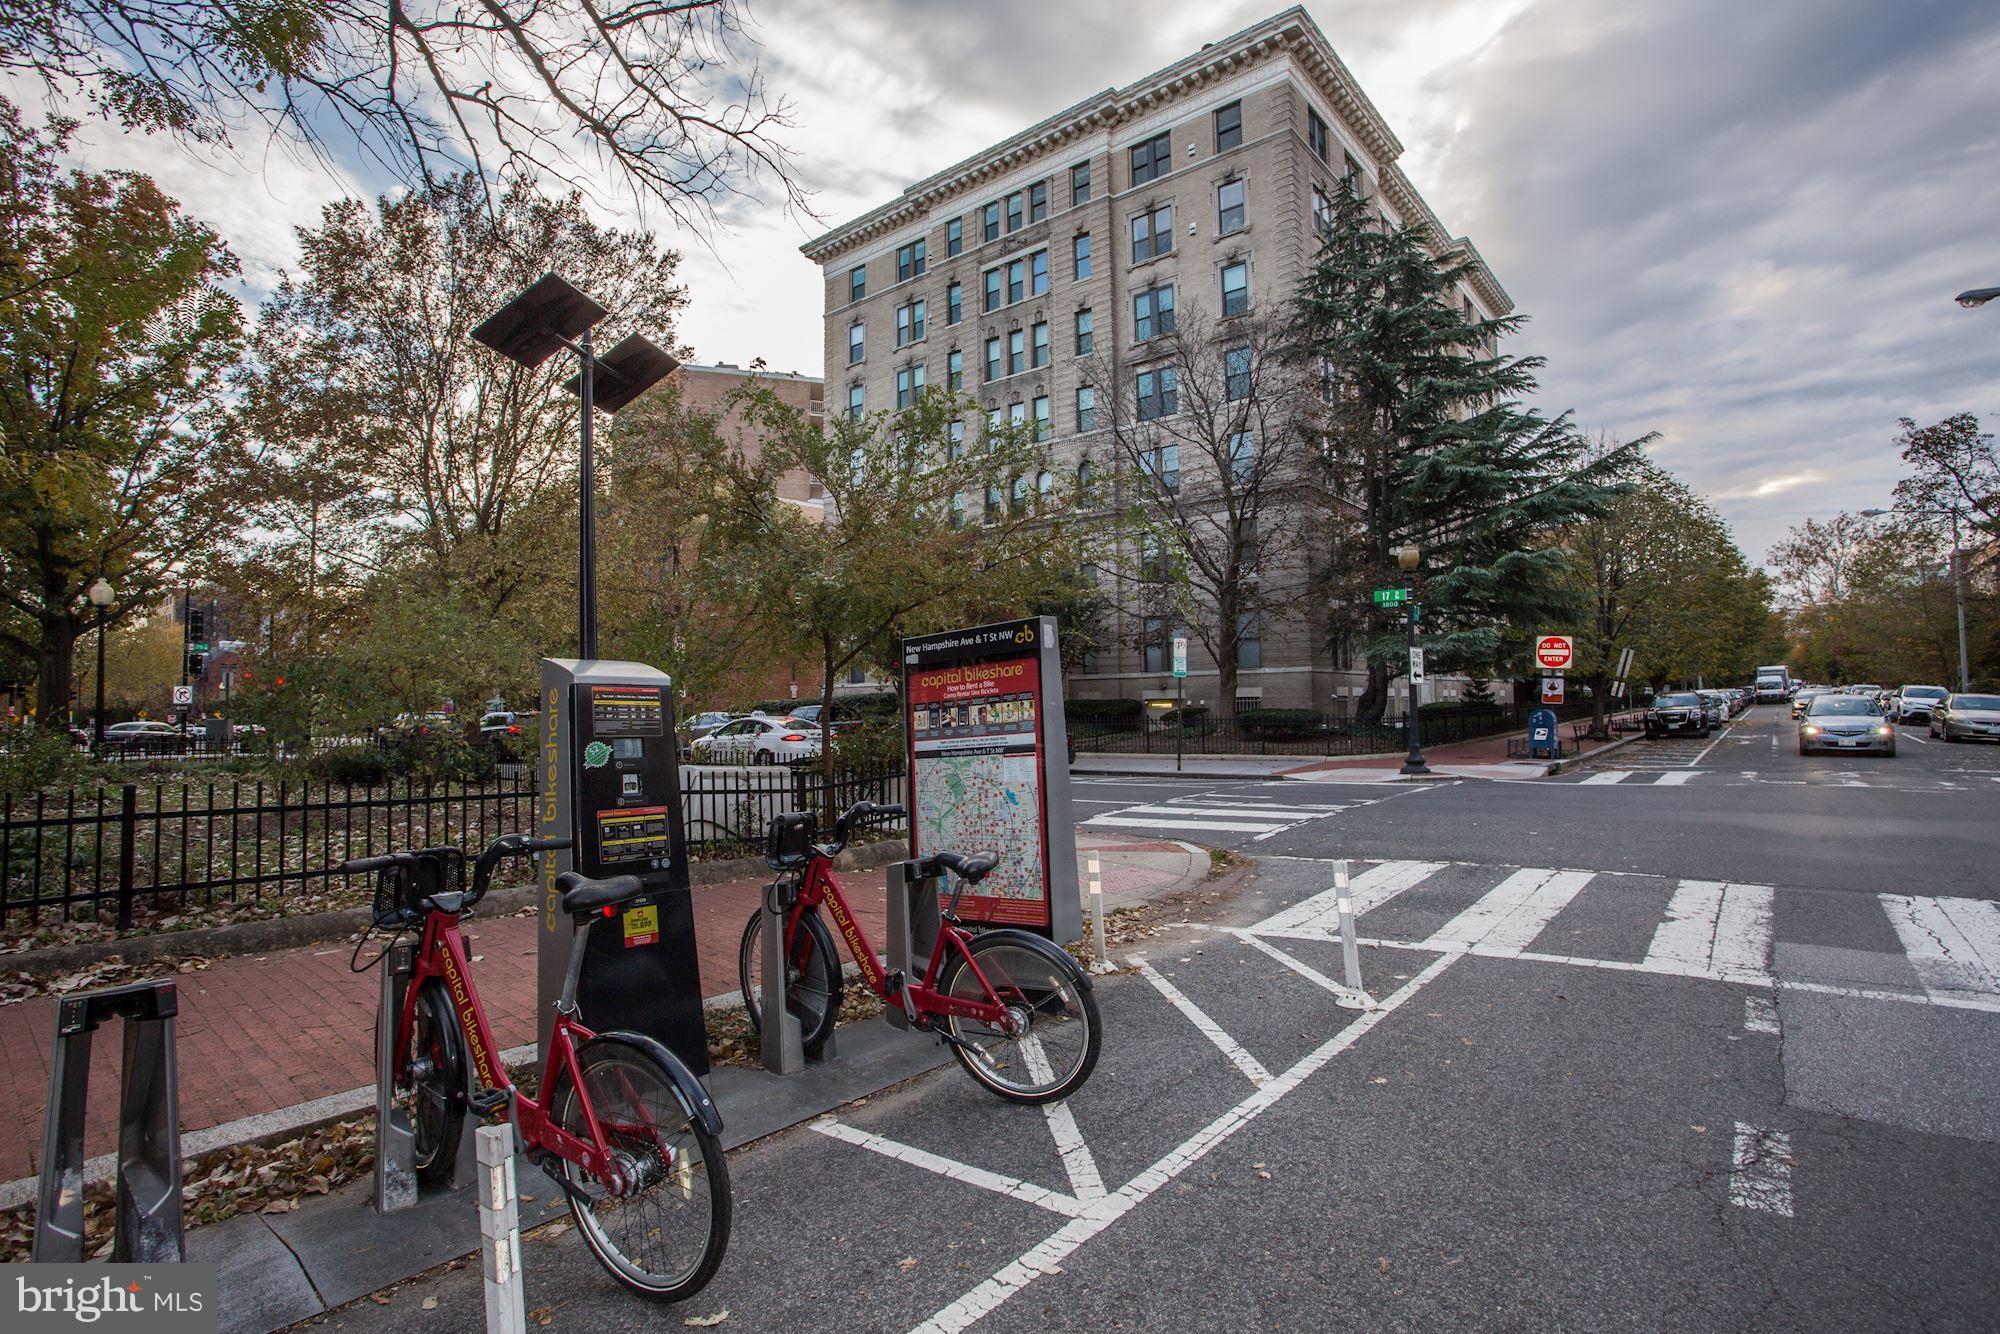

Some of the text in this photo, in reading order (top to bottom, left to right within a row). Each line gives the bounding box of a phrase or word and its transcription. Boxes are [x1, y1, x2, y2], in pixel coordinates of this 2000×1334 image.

[906, 630, 1014, 654] New Hampshire Ave & T St NW
[921, 664, 1024, 688] capital bikeshare
[946, 683, 959, 692] How
[966, 682, 978, 690] Rent
[983, 680, 995, 688] Bike
[542, 687, 559, 824] bikeshare
[823, 885, 877, 984] capital bikeshare
[442, 947, 494, 1089] capital bikeshare
